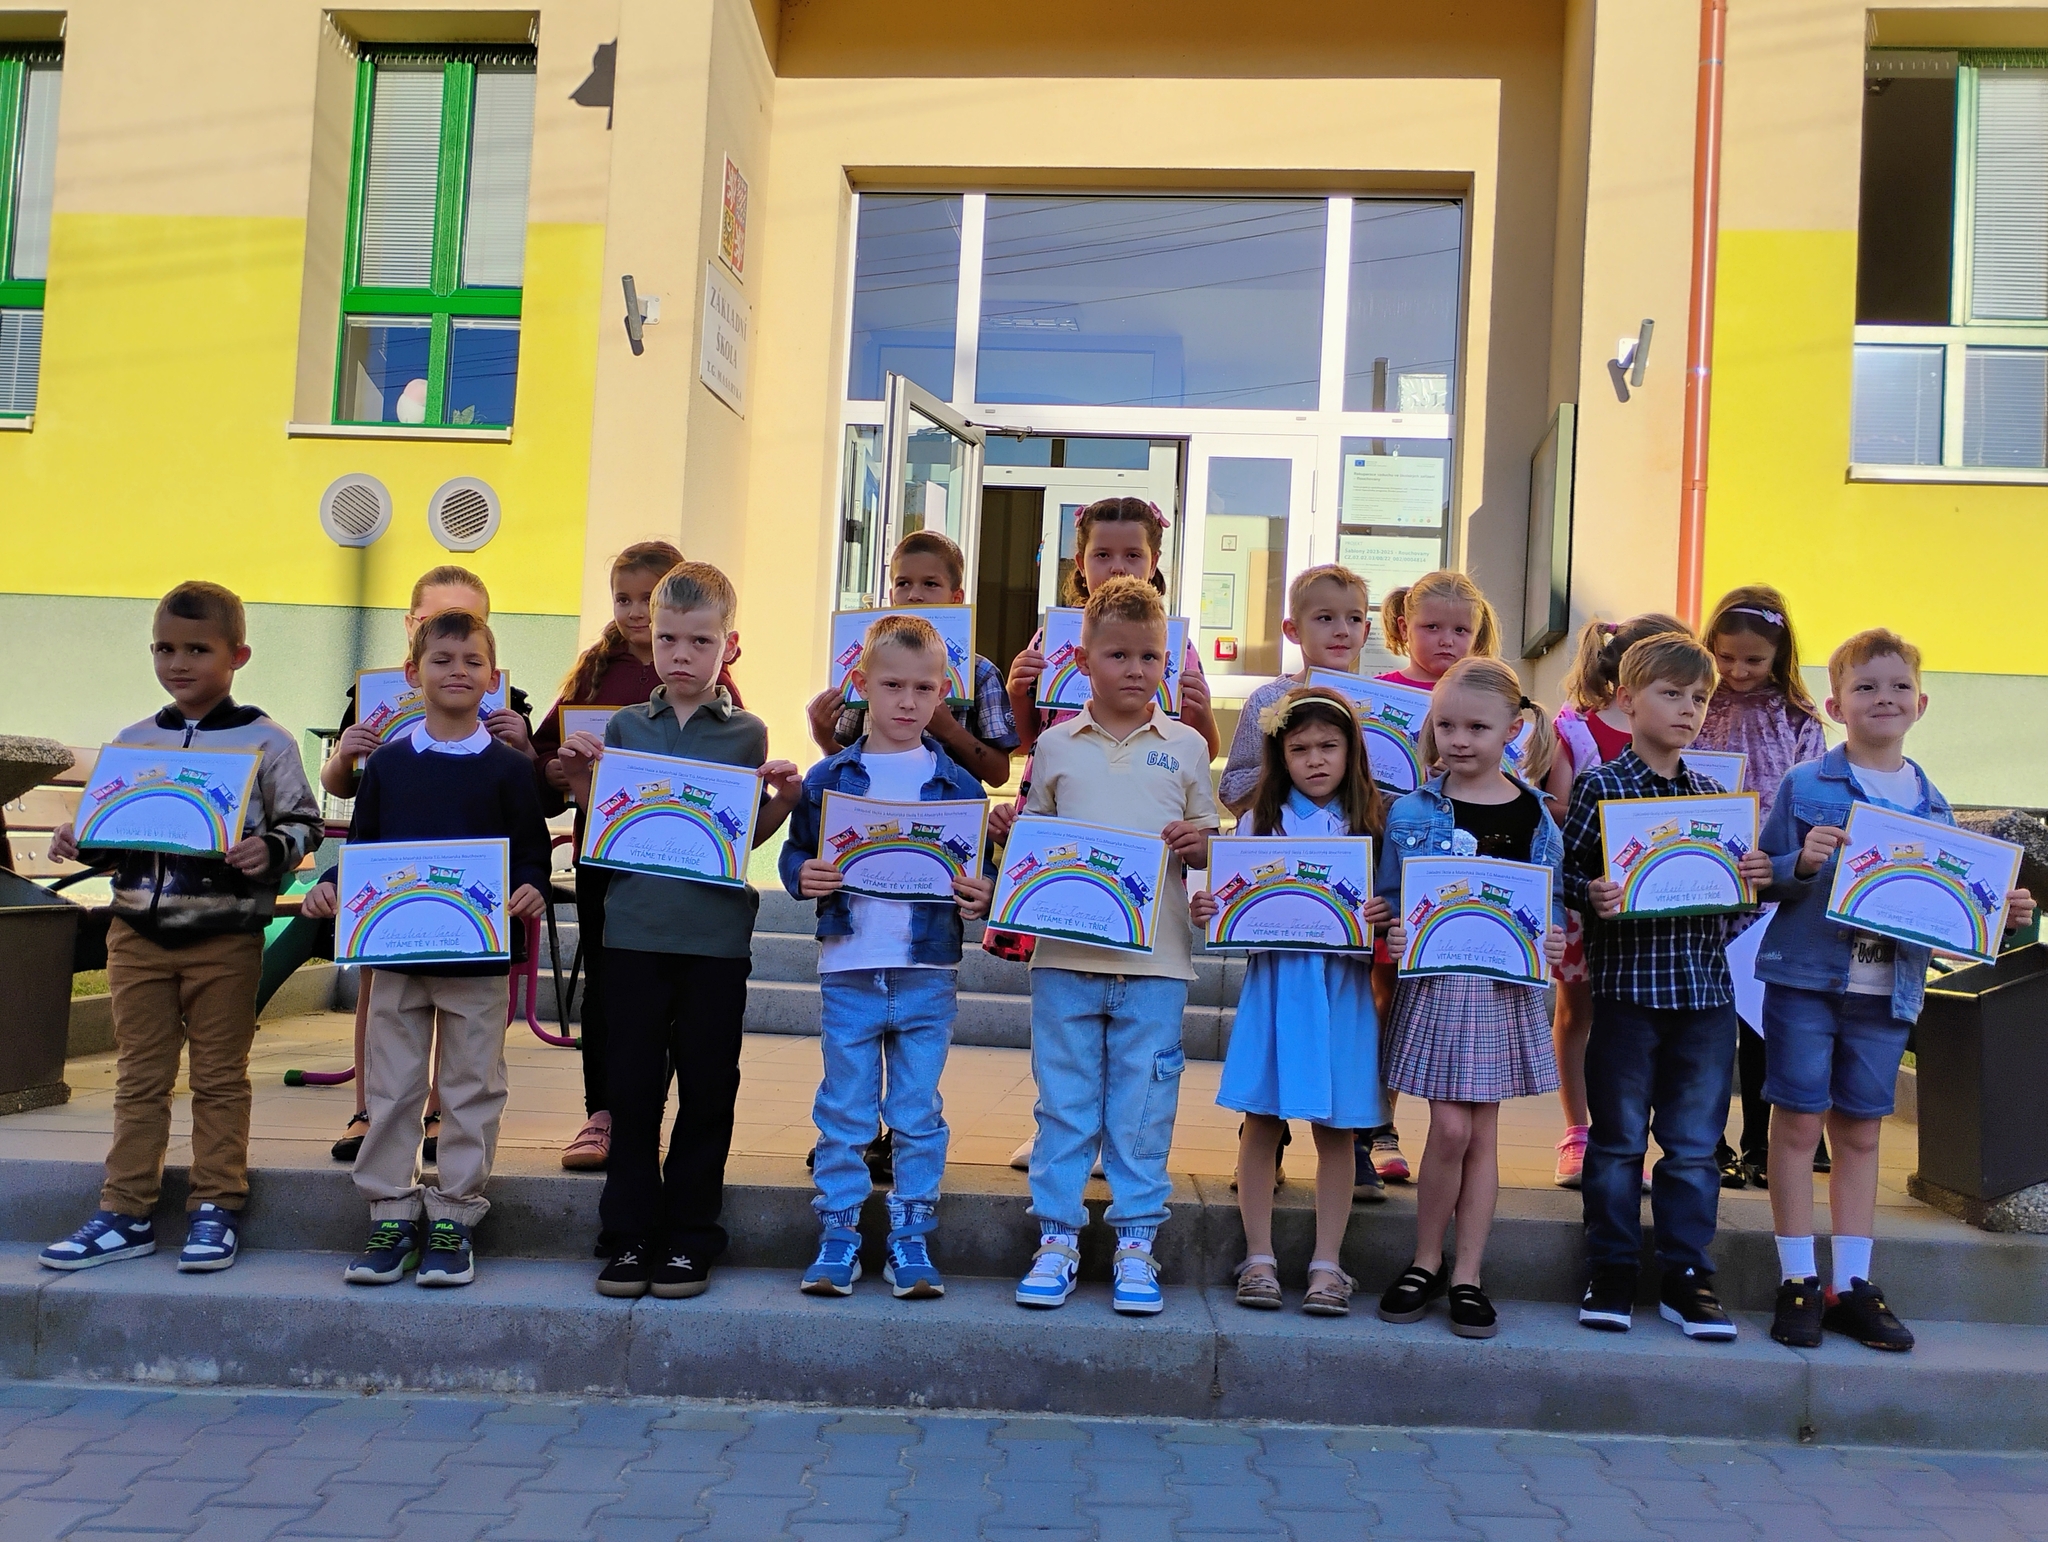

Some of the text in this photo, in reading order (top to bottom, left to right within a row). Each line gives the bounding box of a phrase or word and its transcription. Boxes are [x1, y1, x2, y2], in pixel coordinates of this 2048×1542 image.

[710, 286, 748, 342] ZÁKLADNÍ
[716, 325, 738, 370] ŠKOLA
[1147, 751, 1180, 773] GAP
[630, 849, 655, 859] VÍTÁME
[657, 853, 666, 861] TĚ
[681, 856, 700, 865] TŘÍDĚ
[862, 878, 887, 888] VÍTÁME
[913, 882, 933, 890] TŘÍDĚ
[1036, 913, 1062, 924] VÍTÁME
[1064, 917, 1073, 926] TĚ
[1088, 922, 1108, 932] TŘÍDĚ
[1252, 928, 1279, 936] VÍTÁME
[1281, 929, 1289, 937] TĚ
[1305, 930, 1325, 938] TŘÍDĚ
[385, 939, 412, 948] VÍTÁME
[414, 939, 423, 947] TĚ
[440, 937, 460, 946] TŘÍDĚ
[1436, 951, 1462, 960] VÍTÁME
[1463, 953, 1473, 961] TĚ
[1488, 956, 1507, 965] TŘÍDĚ
